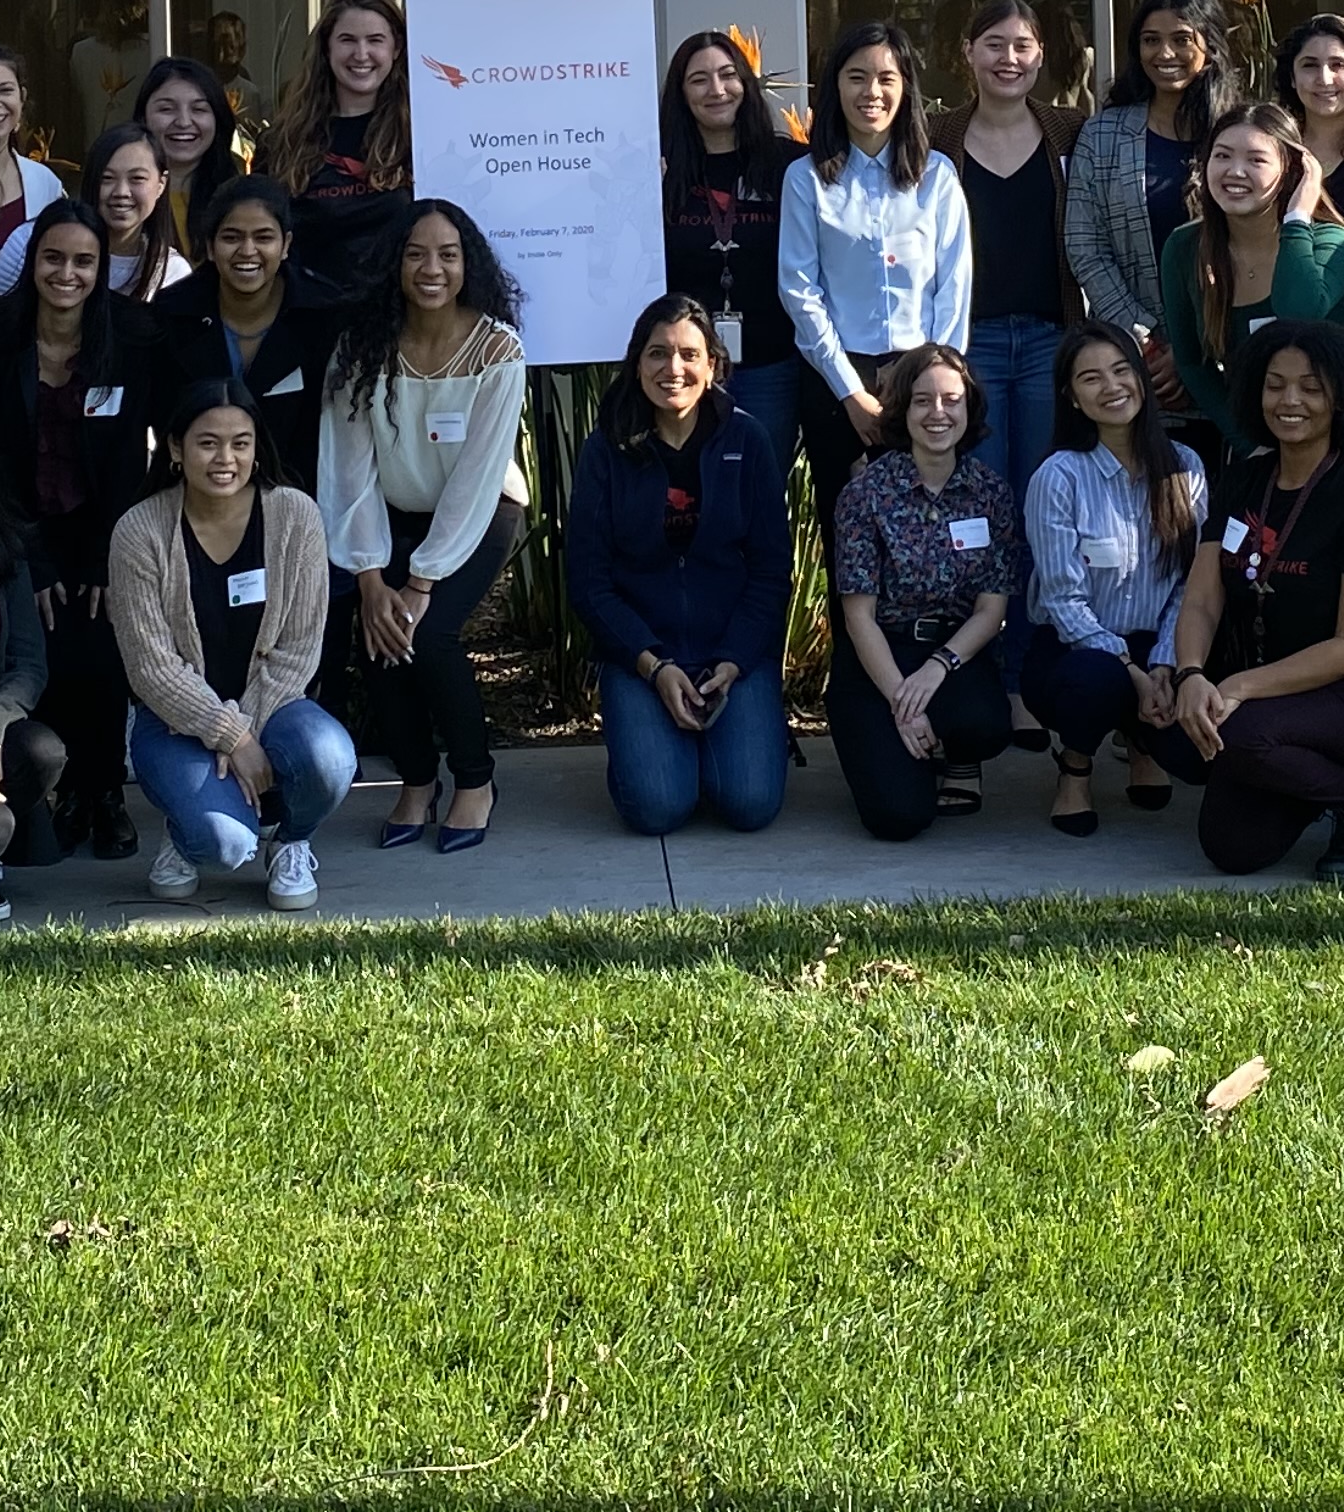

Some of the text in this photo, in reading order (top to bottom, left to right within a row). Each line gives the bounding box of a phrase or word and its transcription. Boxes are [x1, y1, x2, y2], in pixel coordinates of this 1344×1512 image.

[471, 61, 631, 84] CROWDSTRIKE
[469, 127, 605, 149] Women in Tech
[485, 156, 592, 177] Open House
[488, 225, 594, 239] Friday, February 7, 2020
